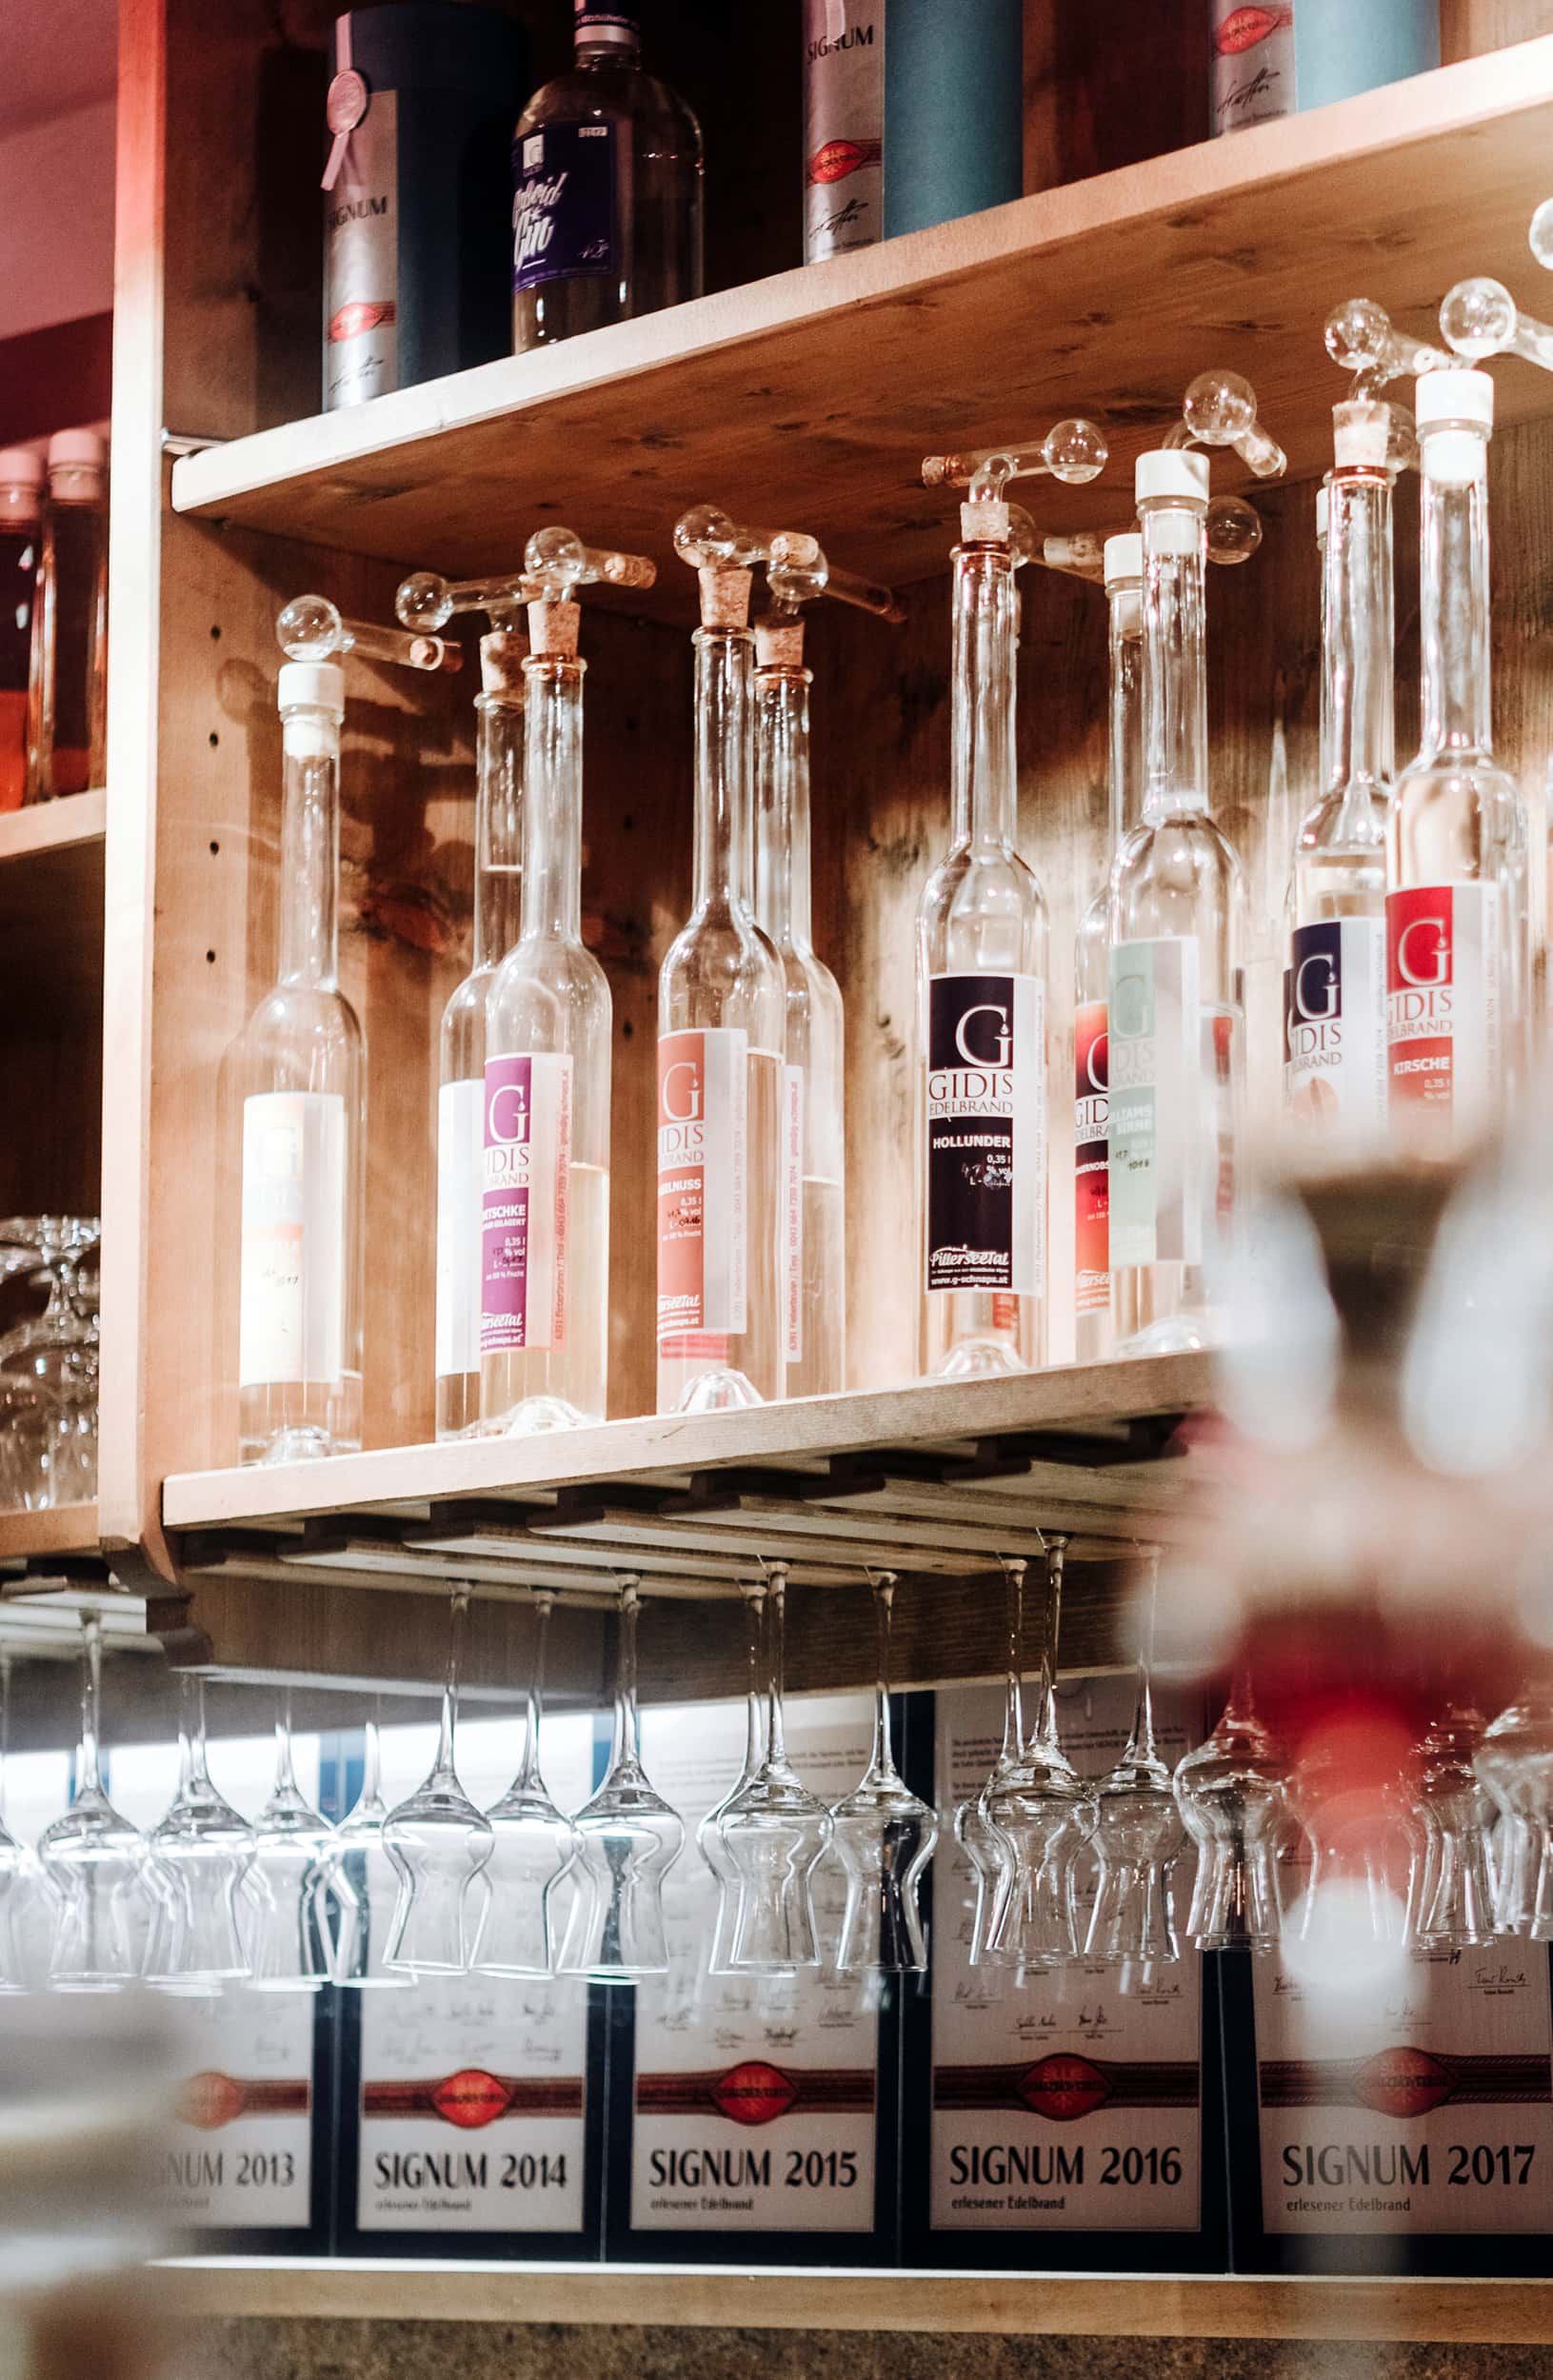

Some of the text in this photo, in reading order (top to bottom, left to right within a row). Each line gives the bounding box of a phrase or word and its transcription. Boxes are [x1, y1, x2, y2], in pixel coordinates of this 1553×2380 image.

[1398, 918, 1450, 987] G
[1297, 954, 1341, 1021] G
[955, 1004, 1013, 1068] G
[1393, 1056, 1450, 1076] KIRSCHE
[662, 1061, 701, 1121] G
[928, 1073, 1013, 1101] GIDIS
[488, 1084, 529, 1144] G
[929, 1101, 1013, 1115] EDELBRAND
[933, 1134, 1011, 1149] HOLLUNDER
[236, 2152, 295, 2187] 2013
[374, 2151, 567, 2189] SIGNUM 2014
[649, 2149, 858, 2188] SIGNUM 2015
[949, 2145, 1183, 2186] SIGNUM 2016
[1282, 2143, 1536, 2187] SIGNUM 2017
[951, 2195, 1065, 2210] erlesener Edelbrand
[1285, 2196, 1411, 2211] erlesener Edelbrand
